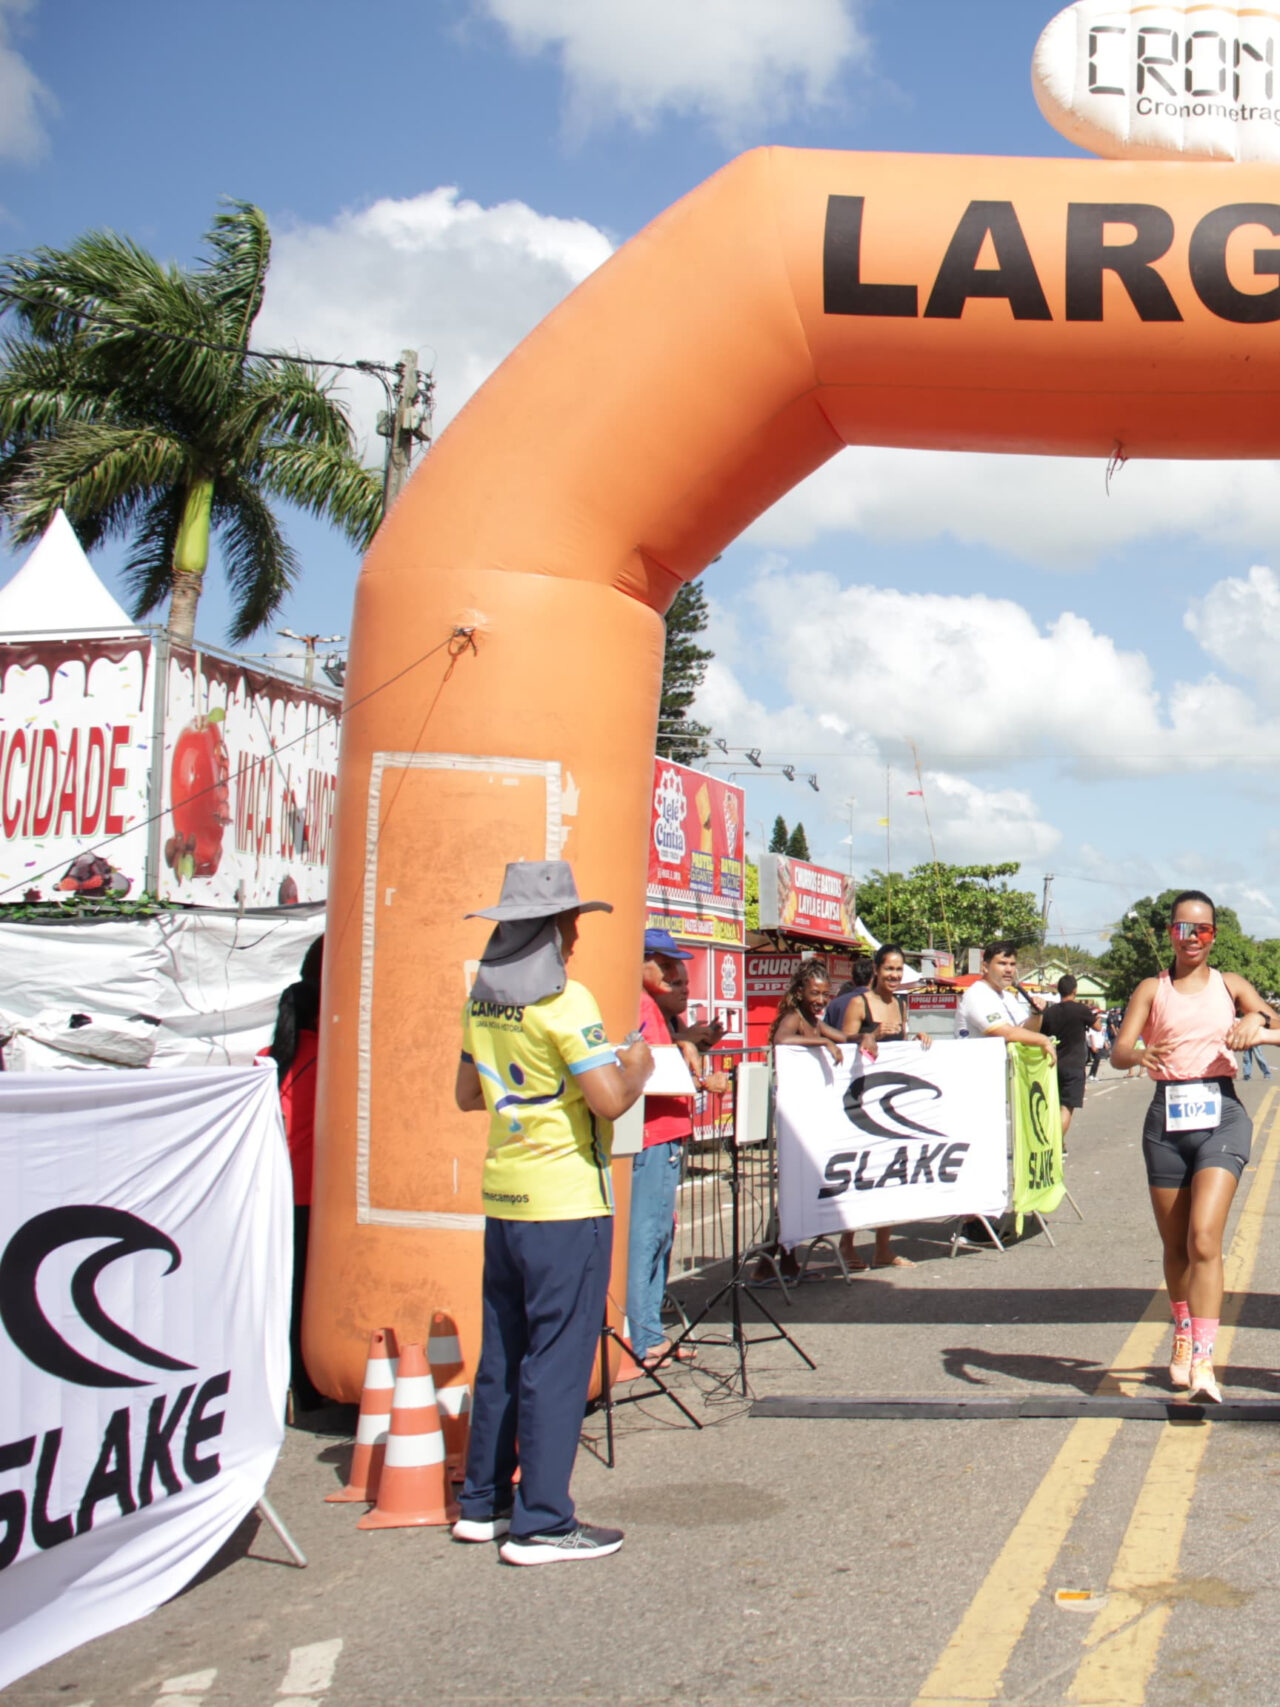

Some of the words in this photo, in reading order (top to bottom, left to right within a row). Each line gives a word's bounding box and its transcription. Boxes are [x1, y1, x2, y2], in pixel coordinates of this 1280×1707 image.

[471, 1000, 526, 1022] CAMPOS
[1178, 1102, 1207, 1118] 102
[817, 1142, 970, 1200] SLAKE
[1028, 1148, 1054, 1191] SLAKE
